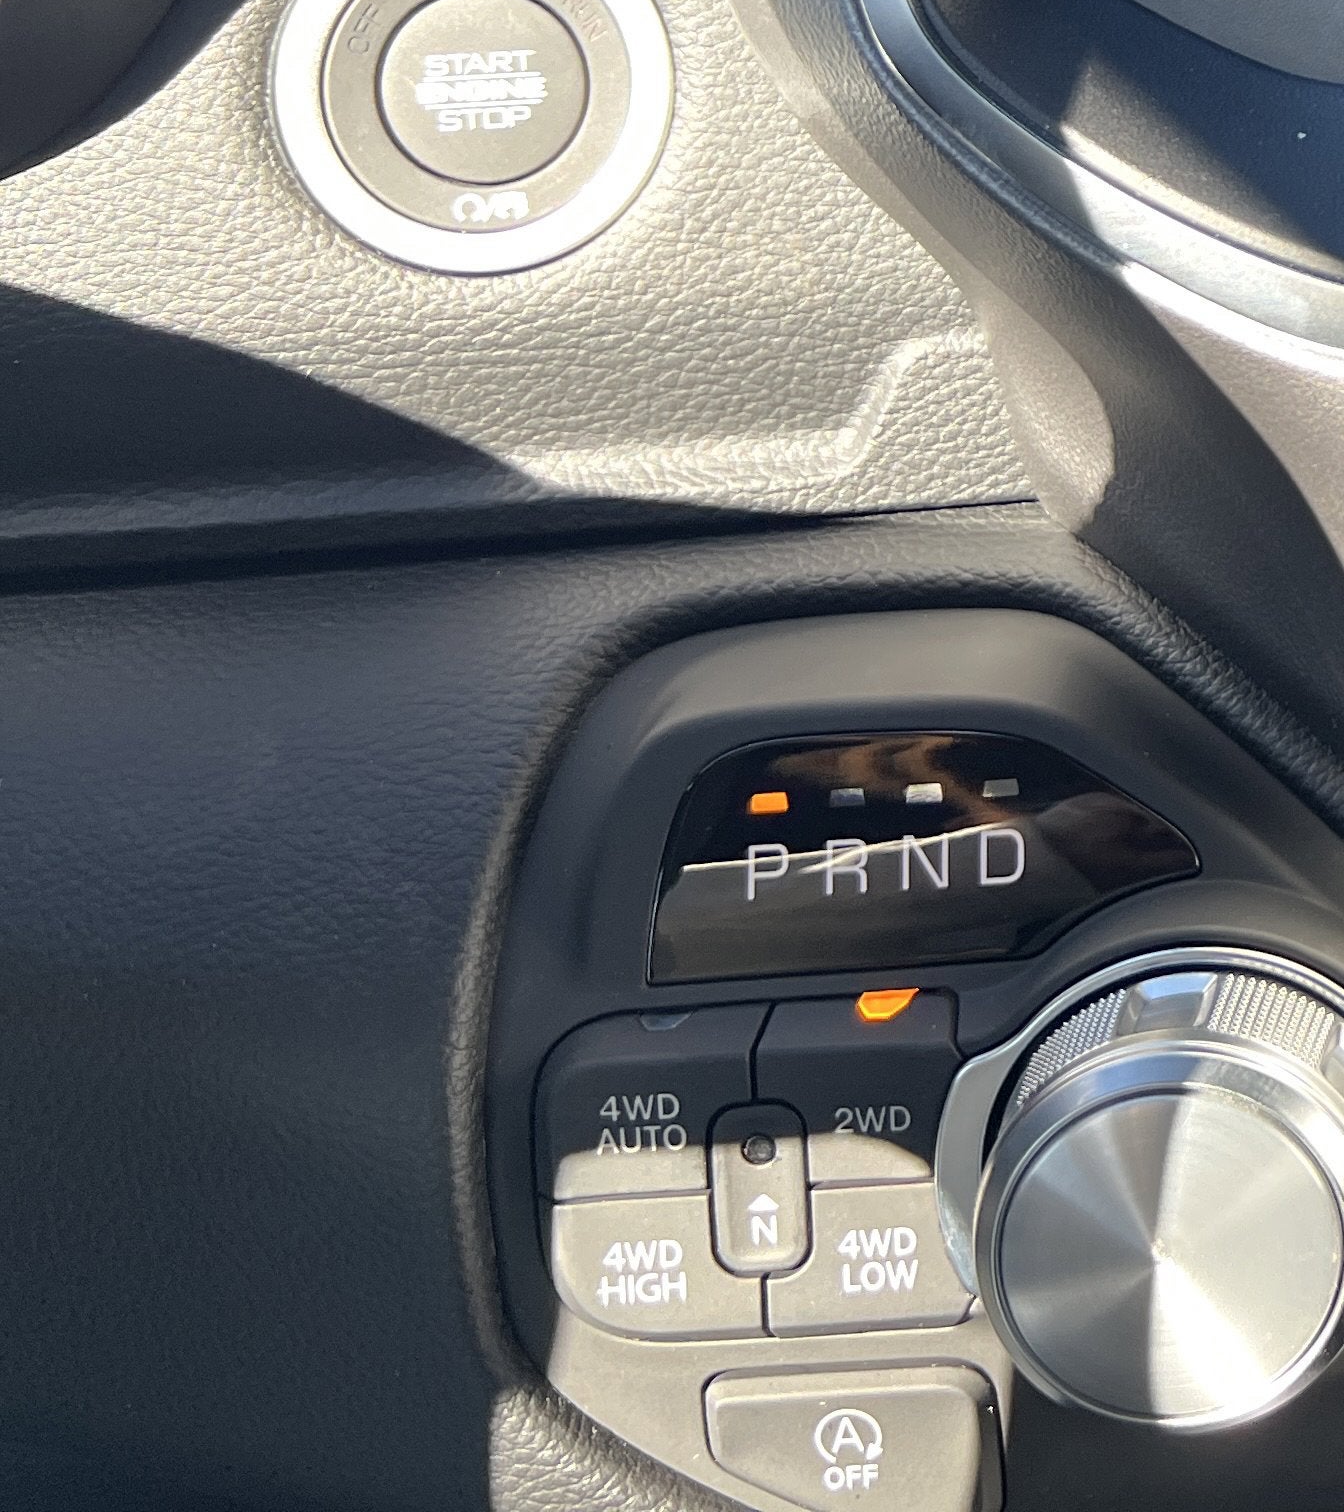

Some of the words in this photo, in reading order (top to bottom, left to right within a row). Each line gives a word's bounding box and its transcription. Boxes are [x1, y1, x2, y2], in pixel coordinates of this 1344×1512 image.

[423, 49, 537, 76] START
[437, 105, 532, 133] STOP
[600, 1091, 680, 1122] 4WD
[834, 1105, 911, 1133] 2WD
[596, 1123, 687, 1156] AUTO
[751, 1213, 779, 1246] N
[837, 1225, 918, 1261] 4WD
[601, 1239, 683, 1273] 4WD
[596, 1273, 688, 1307] HIGH
[840, 1258, 919, 1295] LOW
[822, 1464, 879, 1491] OFF
